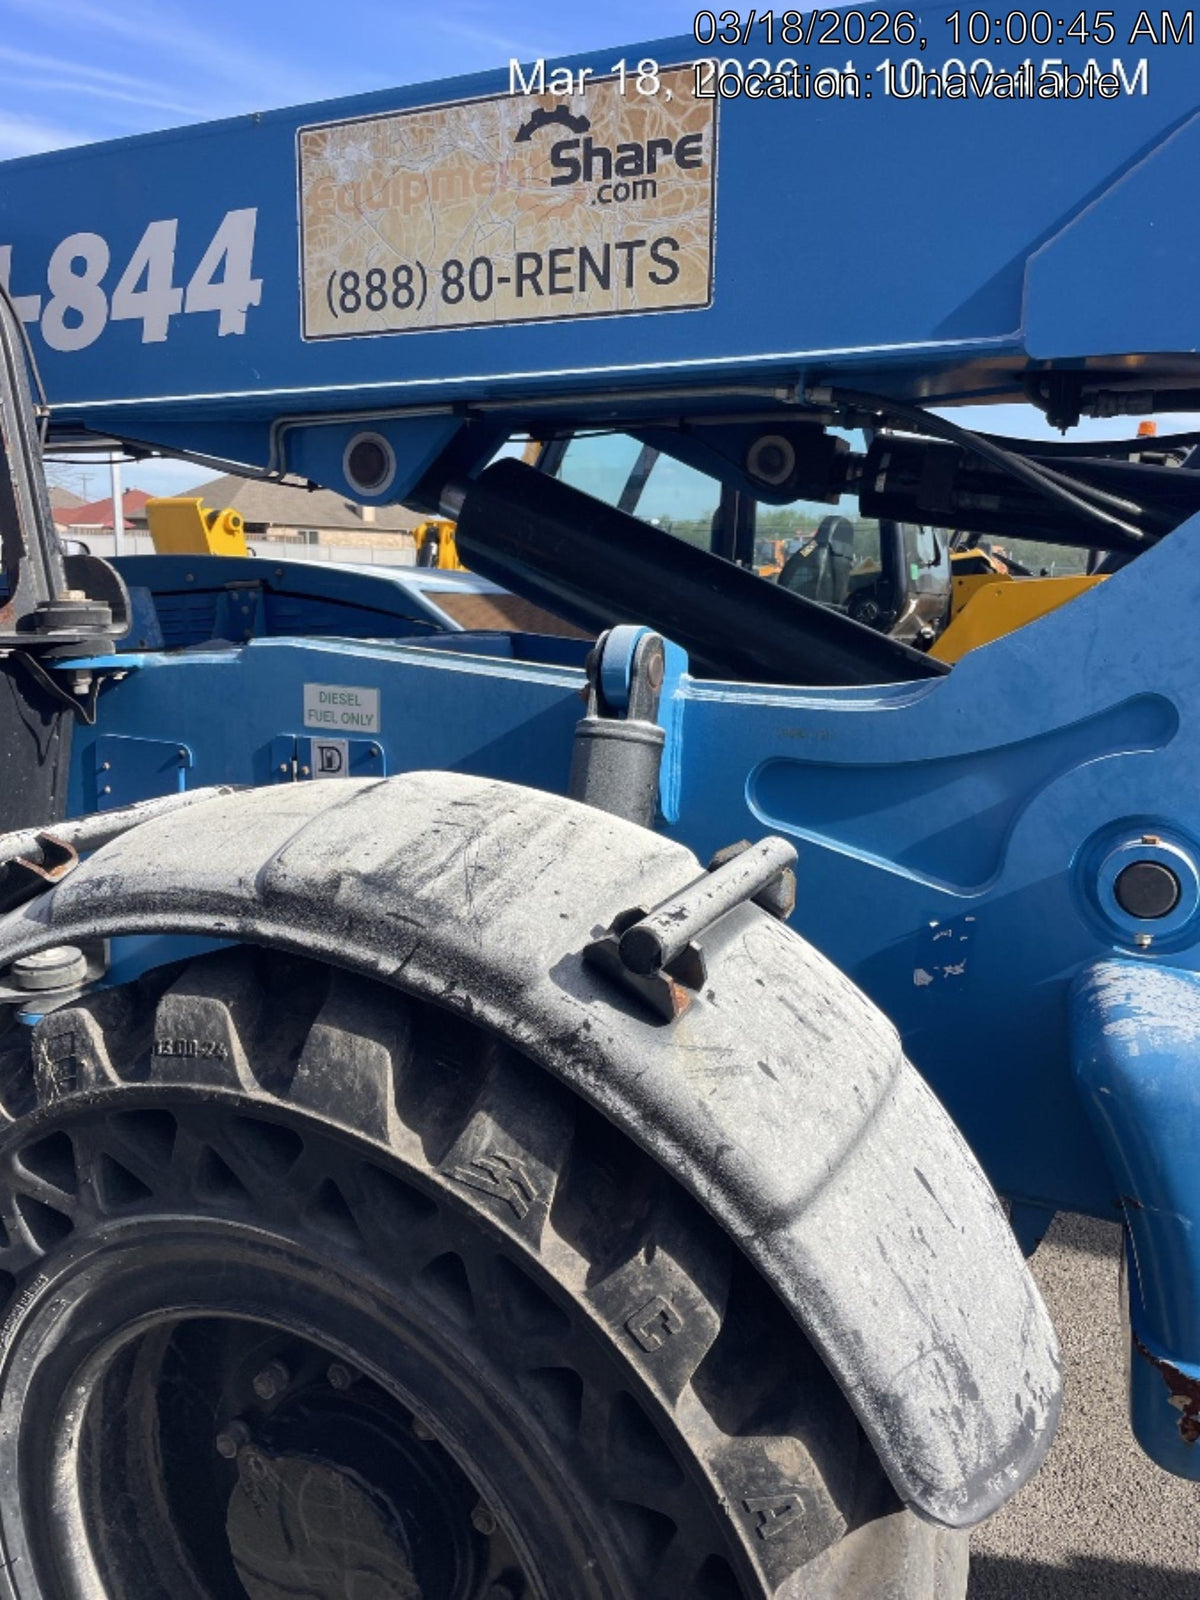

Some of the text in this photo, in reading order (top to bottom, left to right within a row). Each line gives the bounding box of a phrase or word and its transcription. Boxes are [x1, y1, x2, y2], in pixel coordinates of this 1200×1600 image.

[550, 132, 704, 188] Share
[327, 236, 680, 319] (888) 80-RENTS
[319, 690, 362, 707] DIESEL
[307, 708, 375, 727] FUEL ONLY
